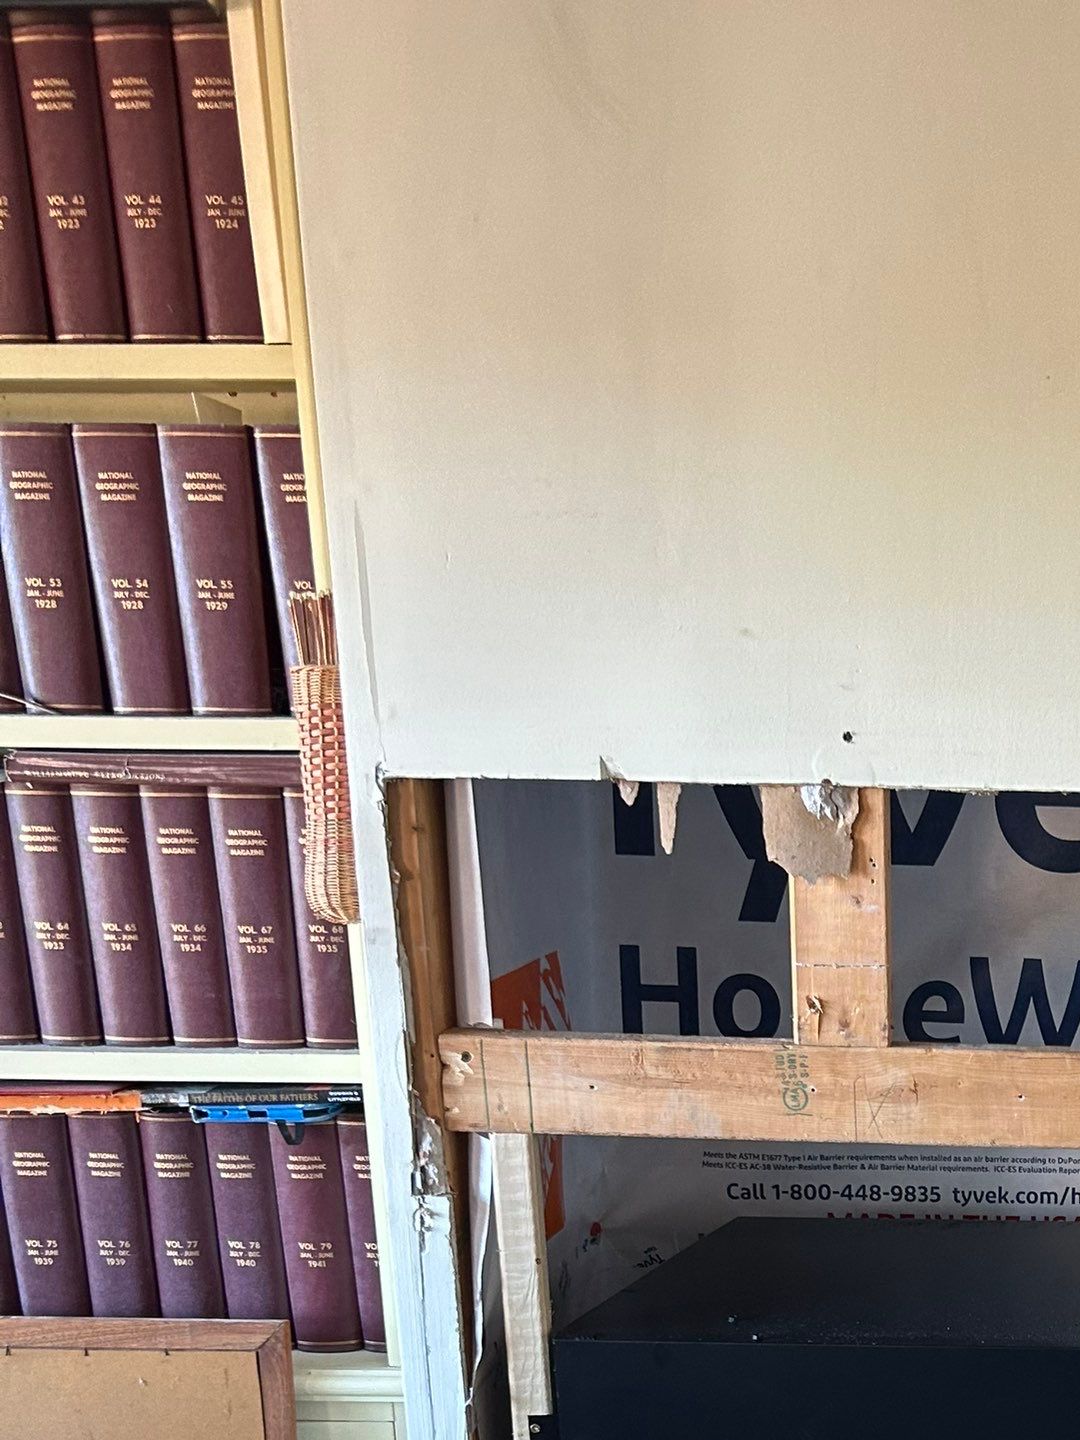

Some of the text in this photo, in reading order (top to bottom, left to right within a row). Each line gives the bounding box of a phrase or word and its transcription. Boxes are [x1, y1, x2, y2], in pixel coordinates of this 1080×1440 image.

[72, 195, 85, 205] 43
[149, 195, 162, 205] 44
[58, 219, 80, 229] 1923
[134, 218, 156, 228] 1923
[12, 471, 46, 479] NATIONAL
[98, 472, 133, 480] NATIONAL
[185, 472, 221, 480] NATIONAL
[10, 482, 54, 490] GEOGRAPHIC
[96, 483, 139, 491] GEOGRAPHIC
[182, 483, 227, 492] GEOGRAPHIC
[15, 492, 50, 501] MAGAZINE
[100, 493, 136, 501] MAGAZINE
[187, 494, 223, 502] MAGAZINE
[50, 578, 61, 588] 53
[136, 579, 148, 588] 54
[221, 580, 233, 589] 55
[35, 600, 57, 609] 1928
[121, 601, 143, 610] 1928
[206, 601, 228, 610] 1929
[157, 837, 199, 845] GEOGRAPHIC
[161, 847, 196, 855] MAGAZINE
[125, 924, 136, 932] 65
[194, 924, 206, 932] 66
[261, 926, 272, 934] 67
[111, 943, 132, 952] 1934
[180, 944, 201, 952] 1934
[245, 1094, 256, 1102] OF
[259, 1094, 278, 1102] OUR
[280, 1093, 318, 1101] FATHERS
[704, 1151, 724, 1159] Meets
[725, 1152, 736, 1160] the
[784, 1154, 801, 1162] Type
[847, 1155, 896, 1163] requirements
[985, 1155, 1009, 1163] barrier
[1011, 1156, 1046, 1165] according
[702, 1160, 723, 1168] Meets
[725, 1161, 748, 1169] ICC-ES
[773, 1162, 831, 1171] Water-Resistive
[833, 1162, 857, 1171] Barrier
[860, 1163, 866, 1171] &
[869, 1163, 878, 1171] Air
[881, 1163, 905, 1171] Barrier
[907, 1164, 937, 1172] Material
[726, 1182, 766, 1200] Call
[772, 1184, 941, 1203] 1-800-448-9835
[46, 1240, 57, 1248] 75
[34, 1258, 53, 1266] 1939
[308, 1260, 326, 1268] 1941
